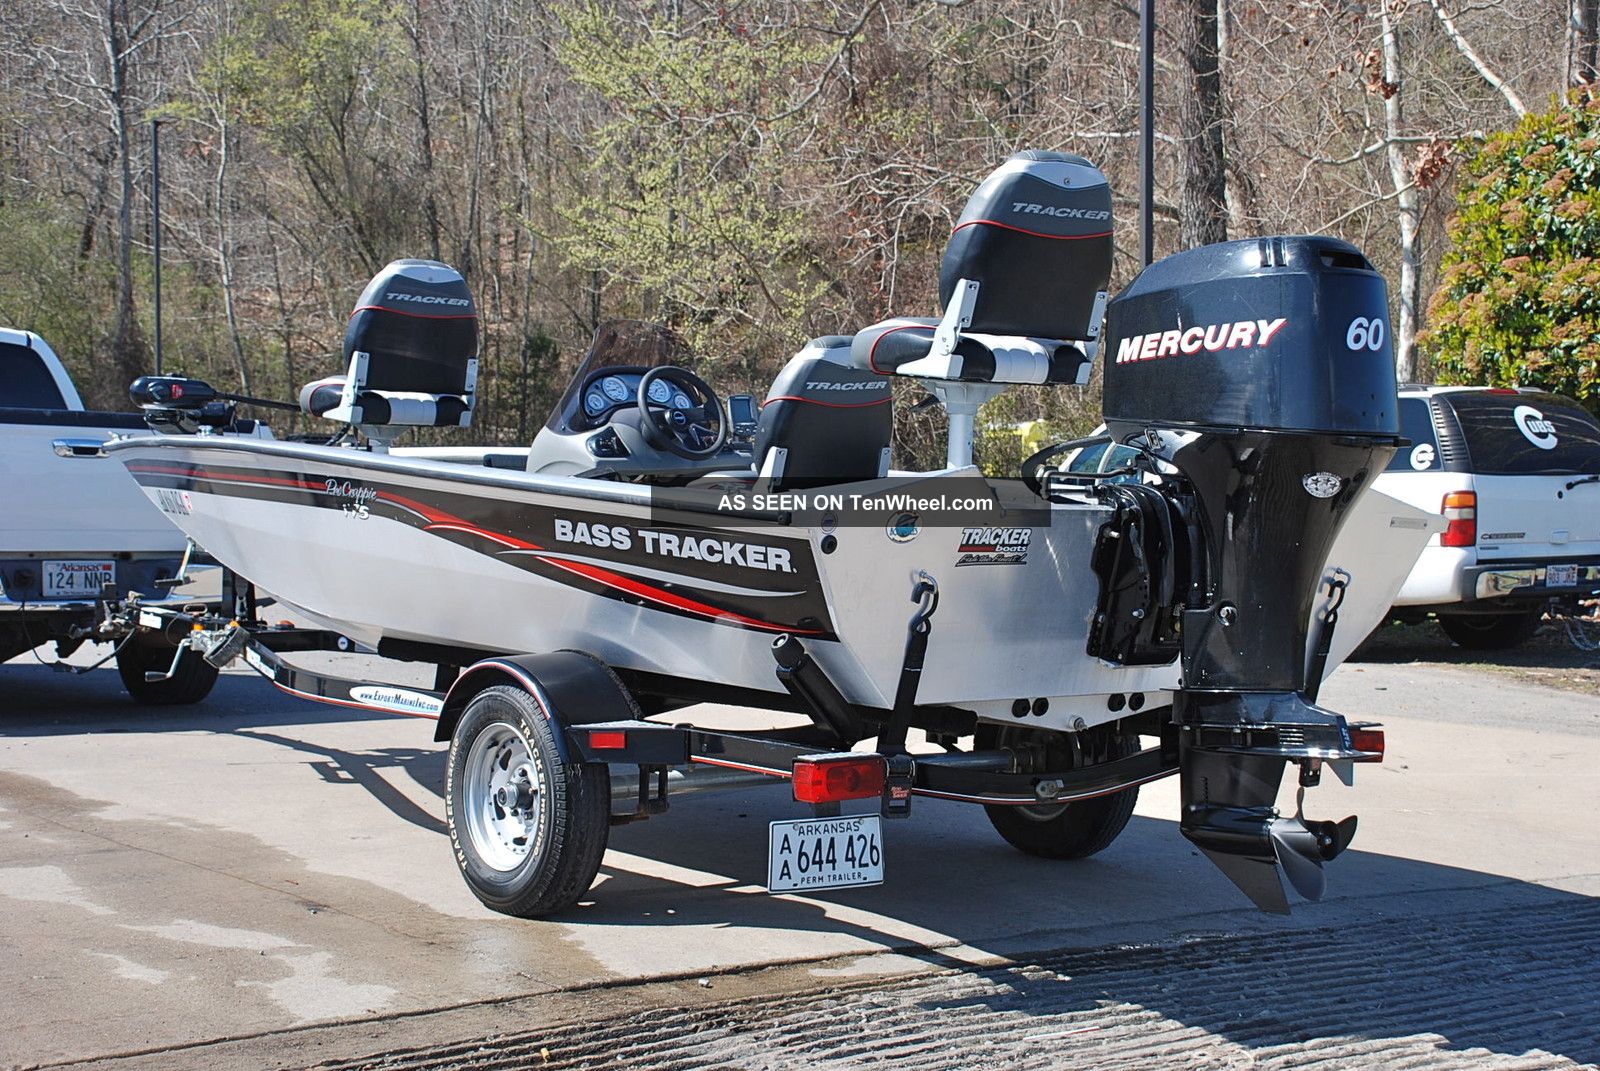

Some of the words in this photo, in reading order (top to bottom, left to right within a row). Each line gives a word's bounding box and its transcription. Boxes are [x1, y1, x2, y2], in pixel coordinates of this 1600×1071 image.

[1012, 202, 1111, 220] TRACKER
[386, 292, 470, 307] TRACKER
[1116, 318, 1287, 364] MERCURY
[1346, 316, 1384, 351] 60
[805, 380, 888, 391] TRACKER
[554, 518, 632, 550] BASS
[637, 530, 792, 572] TRACKER
[961, 527, 1032, 545] TRACKER
[995, 545, 1027, 553] boats
[61, 562, 100, 572] Arkansas
[48, 572, 74, 589] 124
[519, 718, 546, 795] TRACKER
[446, 794, 469, 871] TRACKER
[798, 821, 861, 837] ARKANSAS
[780, 833, 792, 854] A
[797, 836, 837, 874] 644
[844, 833, 880, 869] 426
[779, 859, 792, 880] A
[801, 875, 824, 885] PERM
[828, 871, 862, 883] TRAILER
